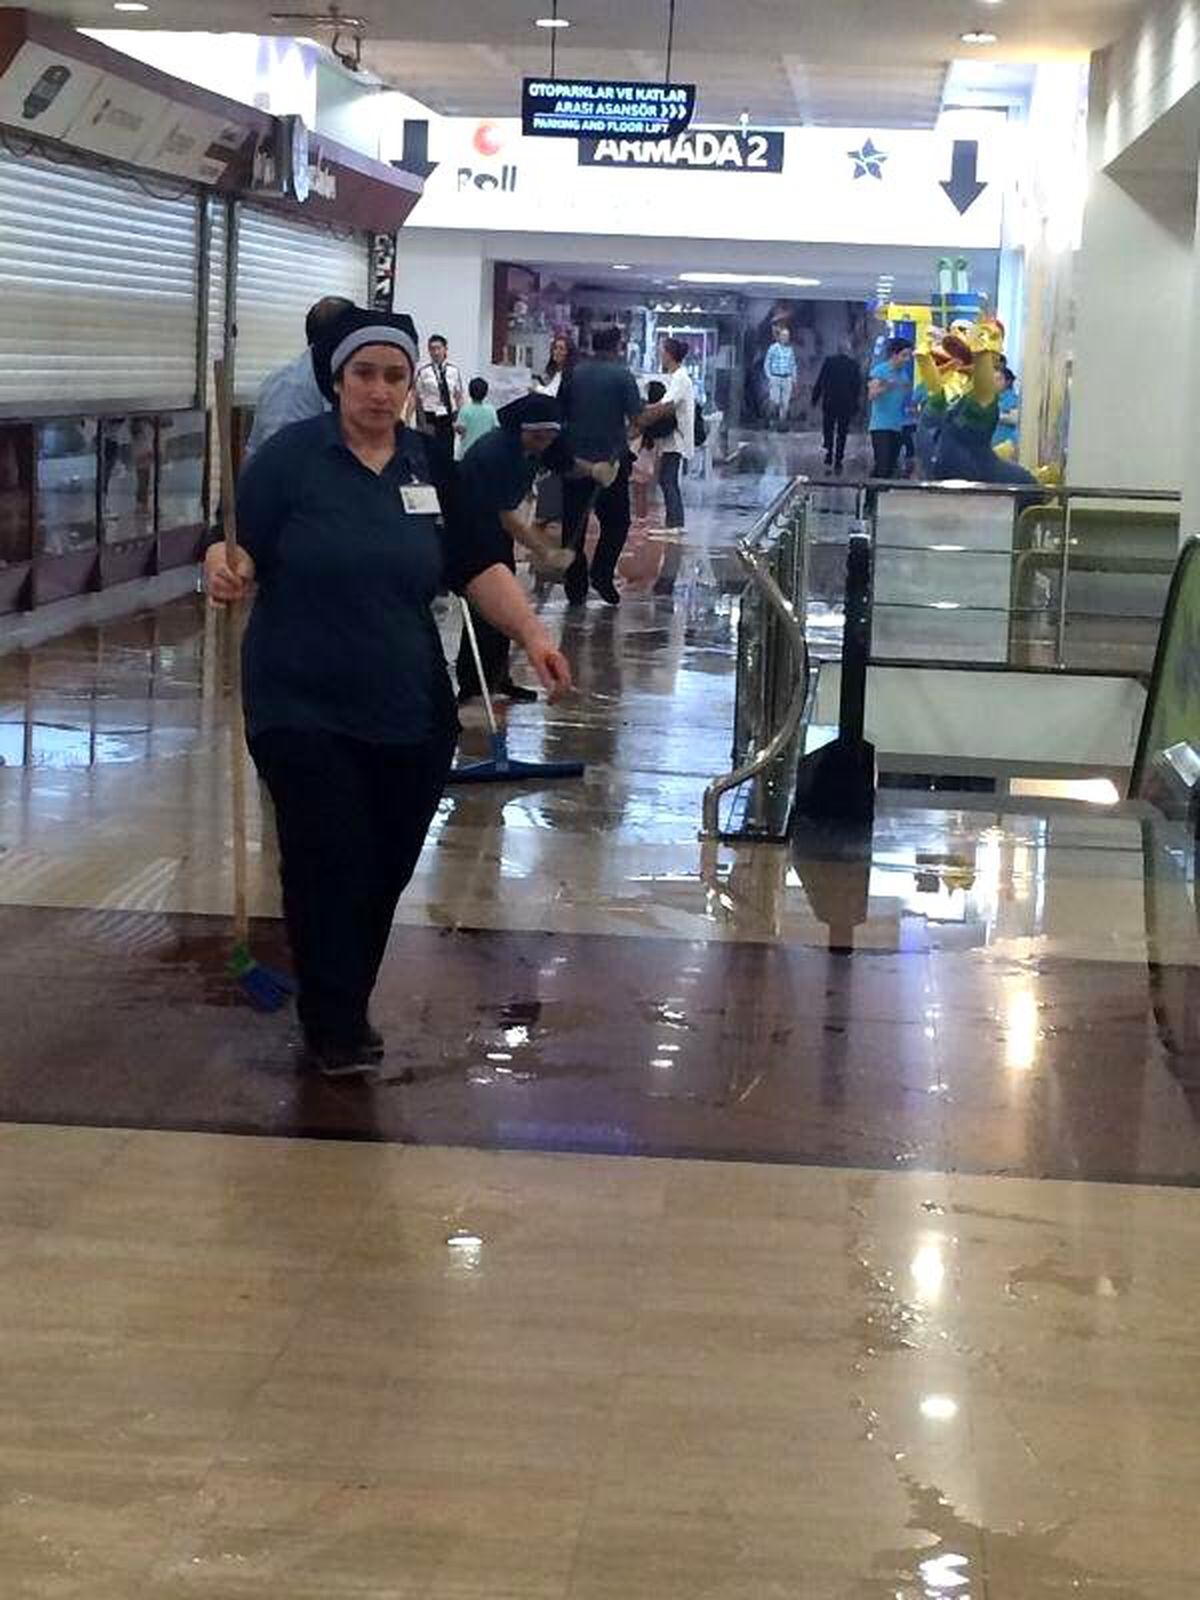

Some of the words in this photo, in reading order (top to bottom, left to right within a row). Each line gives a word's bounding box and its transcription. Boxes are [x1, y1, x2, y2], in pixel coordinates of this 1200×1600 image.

[529, 83, 614, 99] OTOPARKLAR
[616, 87, 633, 100] VE
[635, 88, 687, 102] KATLAR
[554, 101, 593, 113] ARASI
[599, 102, 657, 117] ASANSÖR
[533, 118, 580, 130] PARKING
[581, 120, 606, 131] AND
[607, 121, 644, 133] FLOOR
[645, 123, 669, 134] LIFT
[594, 133, 743, 167] ARMADA
[747, 135, 768, 167] 2
